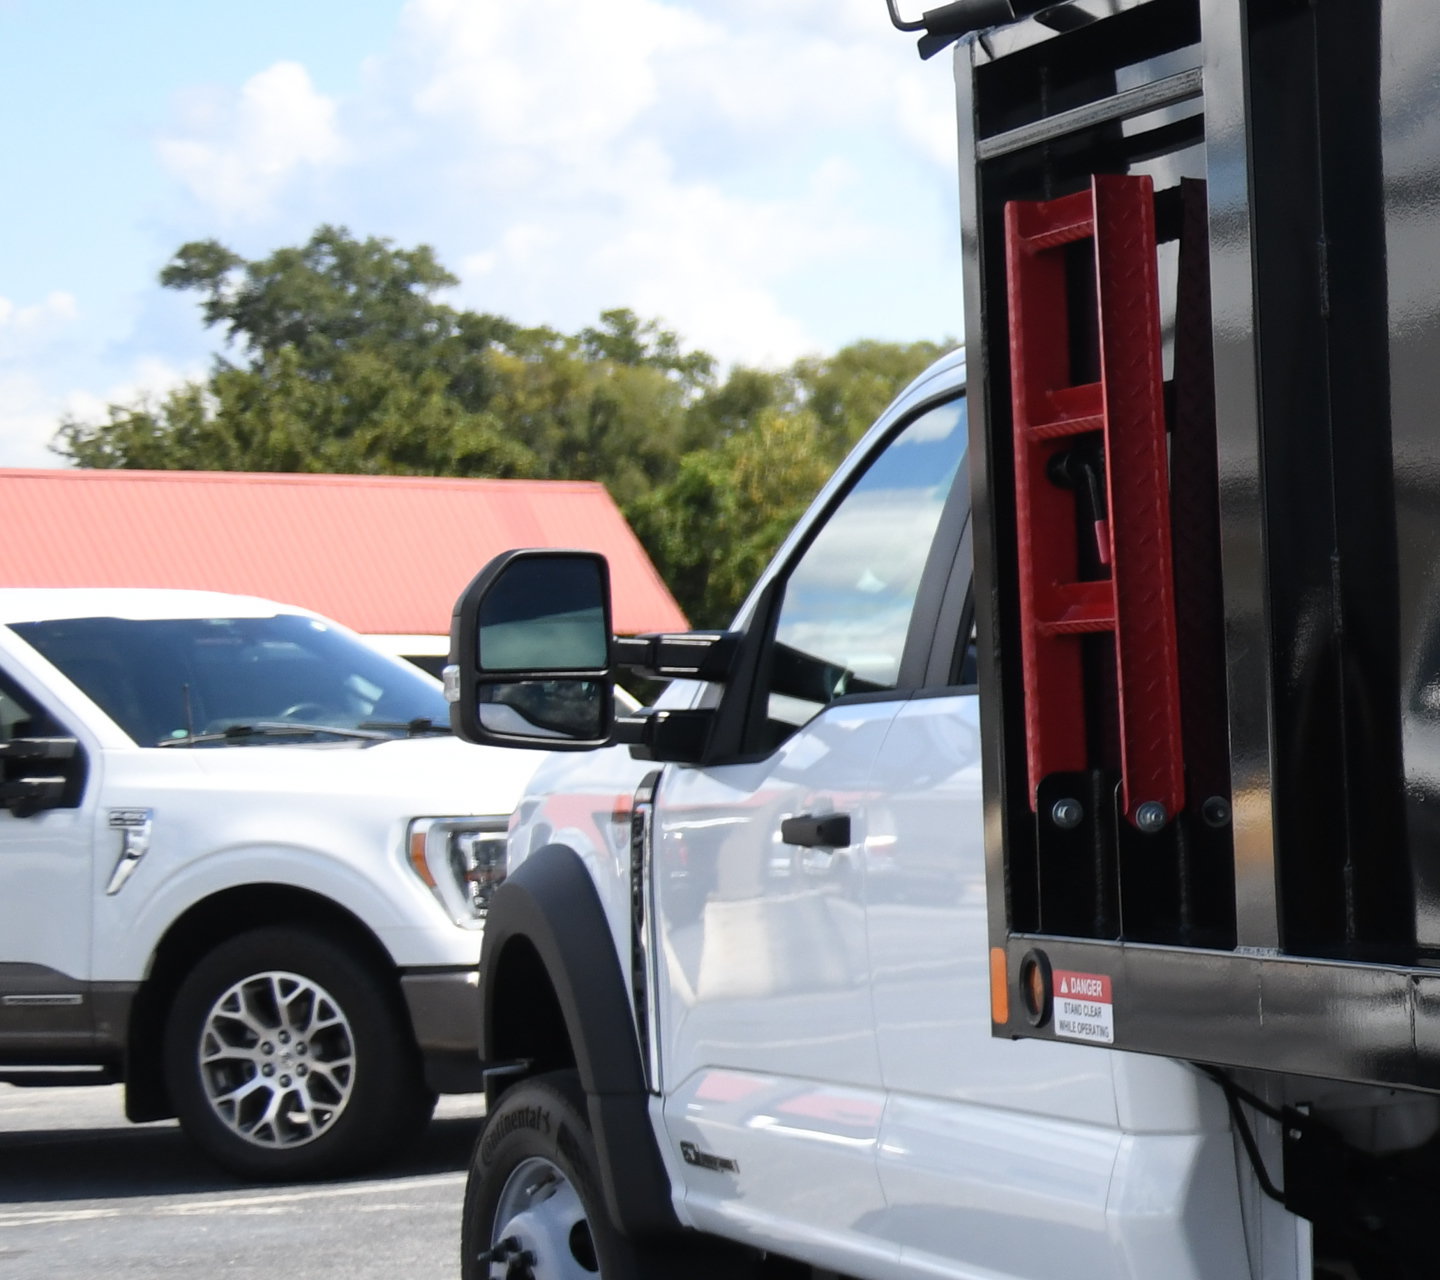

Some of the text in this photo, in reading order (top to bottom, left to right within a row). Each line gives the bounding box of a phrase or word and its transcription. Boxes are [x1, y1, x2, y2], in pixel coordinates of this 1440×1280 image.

[1071, 977, 1103, 997] DANGER
[1064, 1002, 1102, 1018] STAND CLEAR
[1059, 1019, 1109, 1038] WHILE OPERATING
[482, 1106, 542, 1166] Continental
